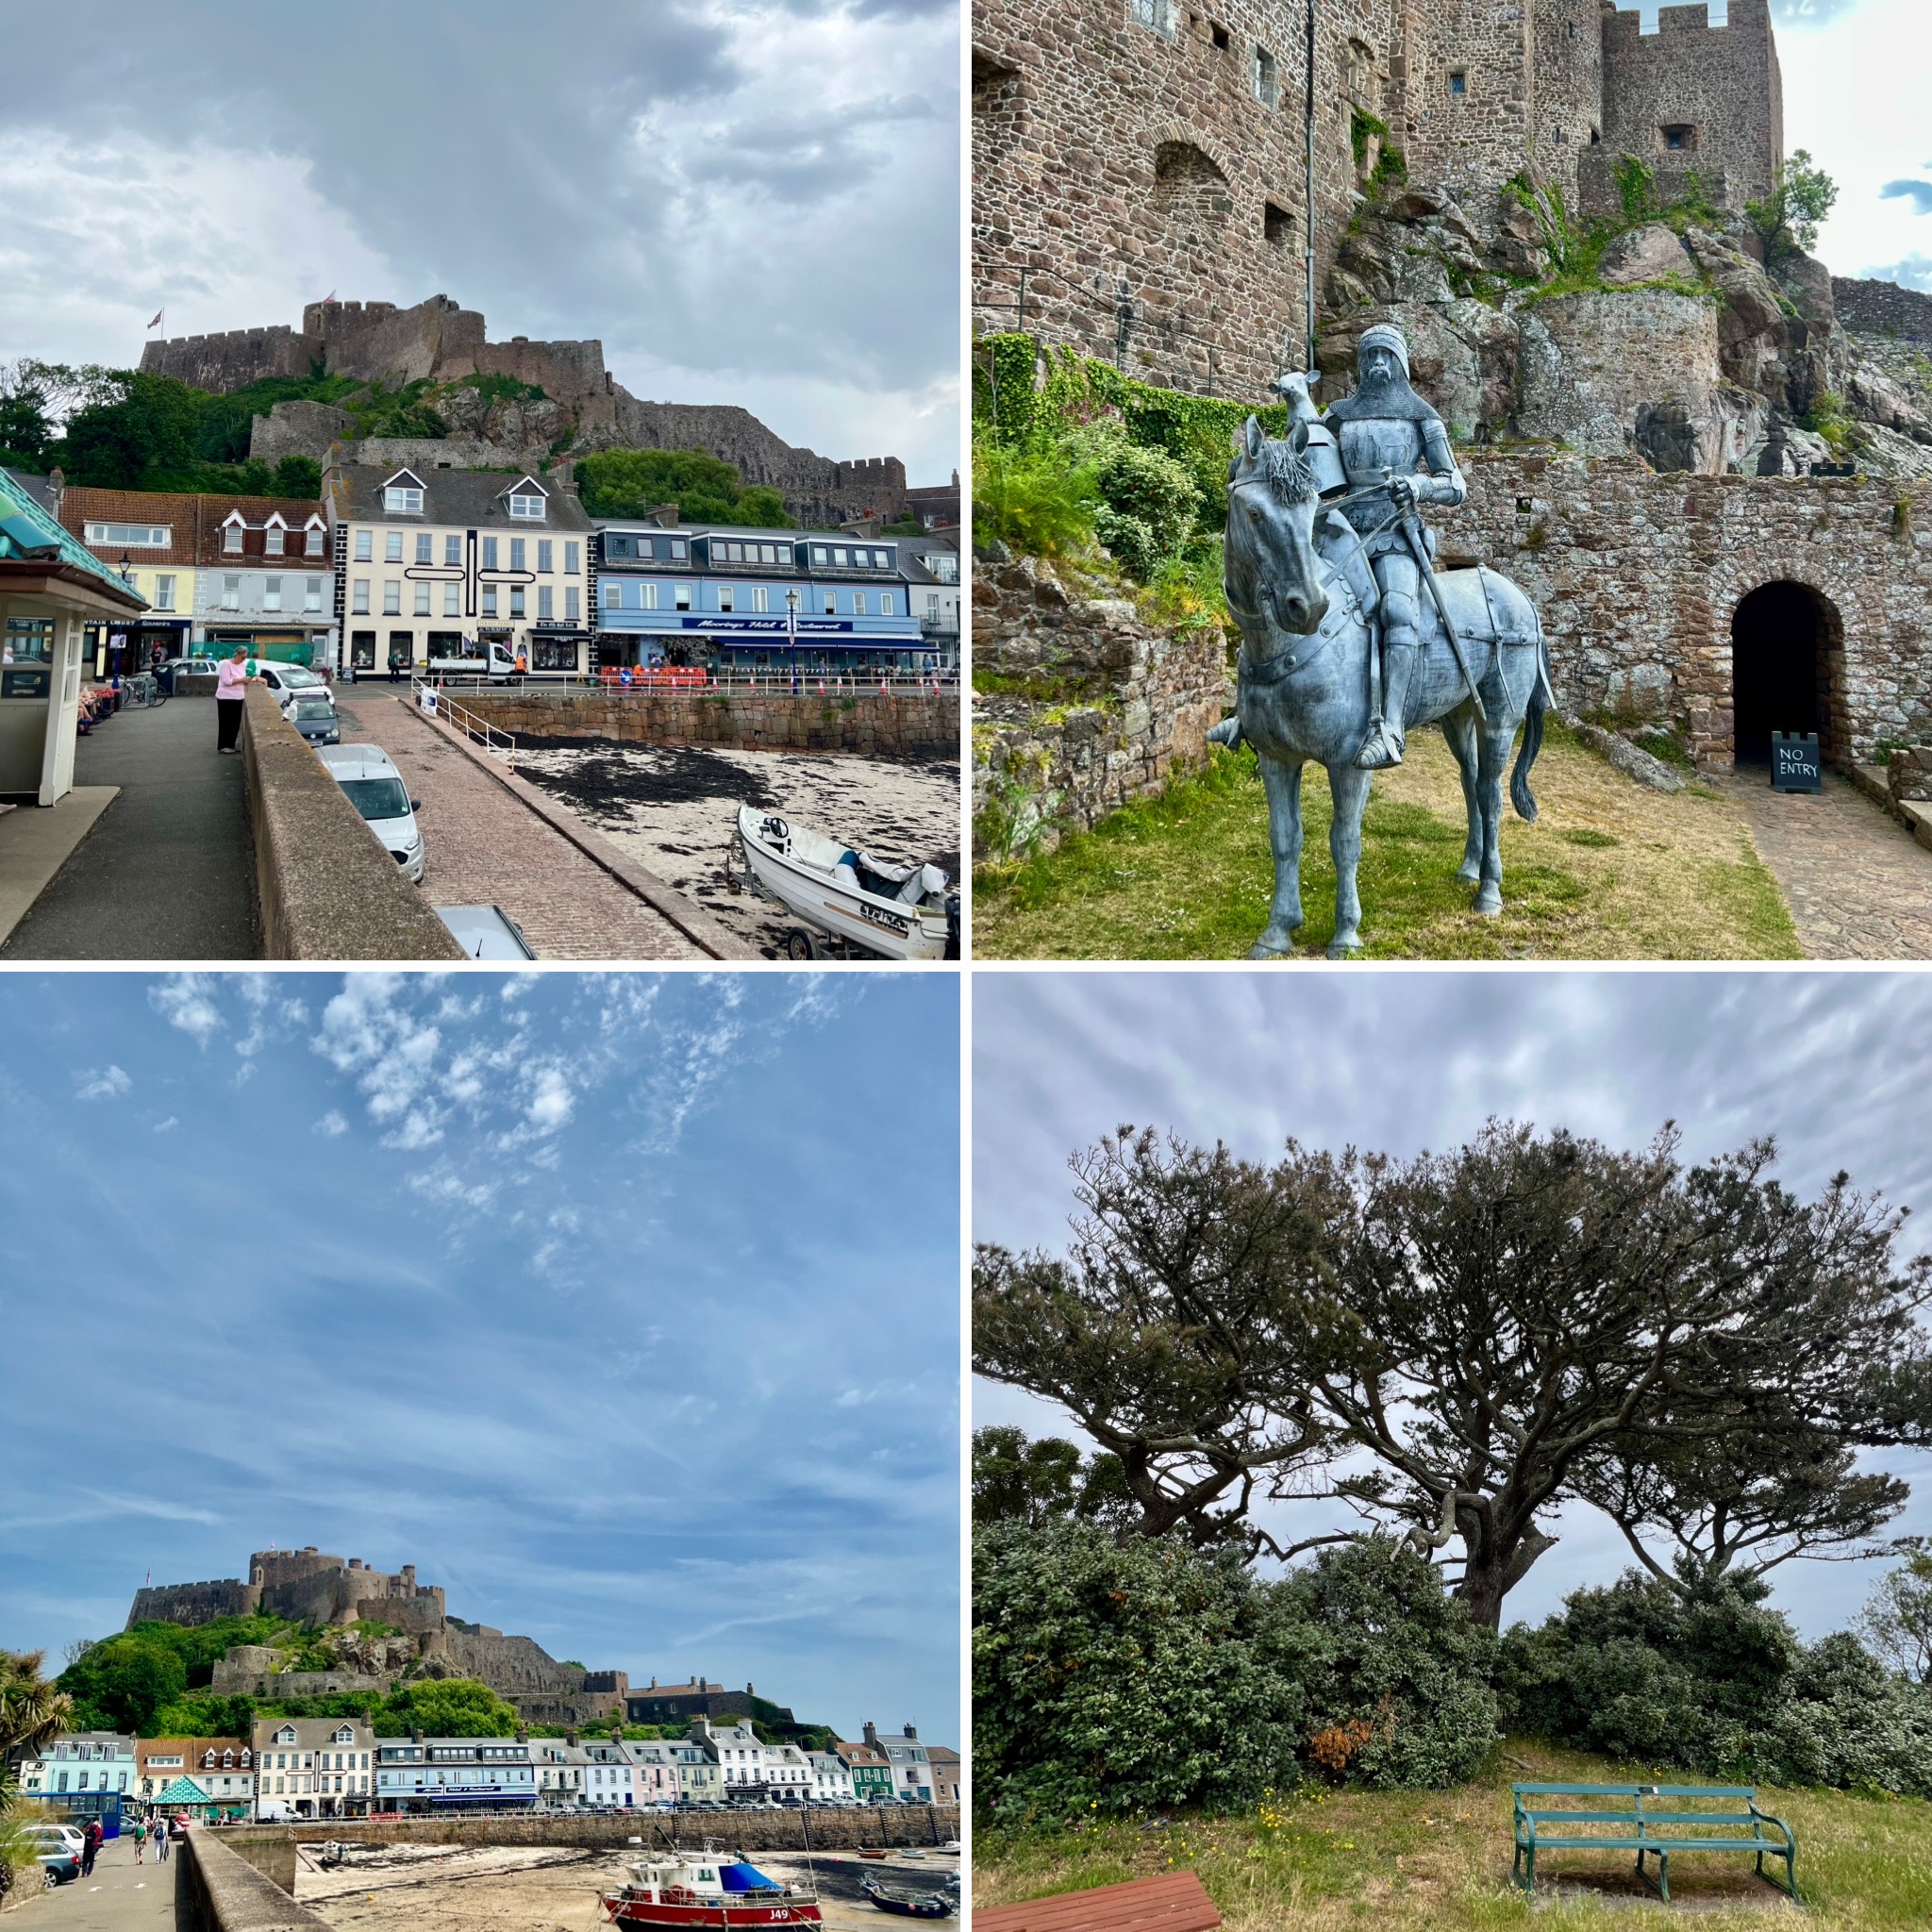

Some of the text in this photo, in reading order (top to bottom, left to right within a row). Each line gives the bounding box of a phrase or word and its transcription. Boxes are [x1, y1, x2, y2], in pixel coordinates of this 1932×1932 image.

[697, 620, 744, 628] Moorings
[748, 621, 777, 629] Hotel
[1779, 748, 1804, 760] NO
[1780, 762, 1818, 777] ENTRY
[770, 1908, 789, 1920] J49
